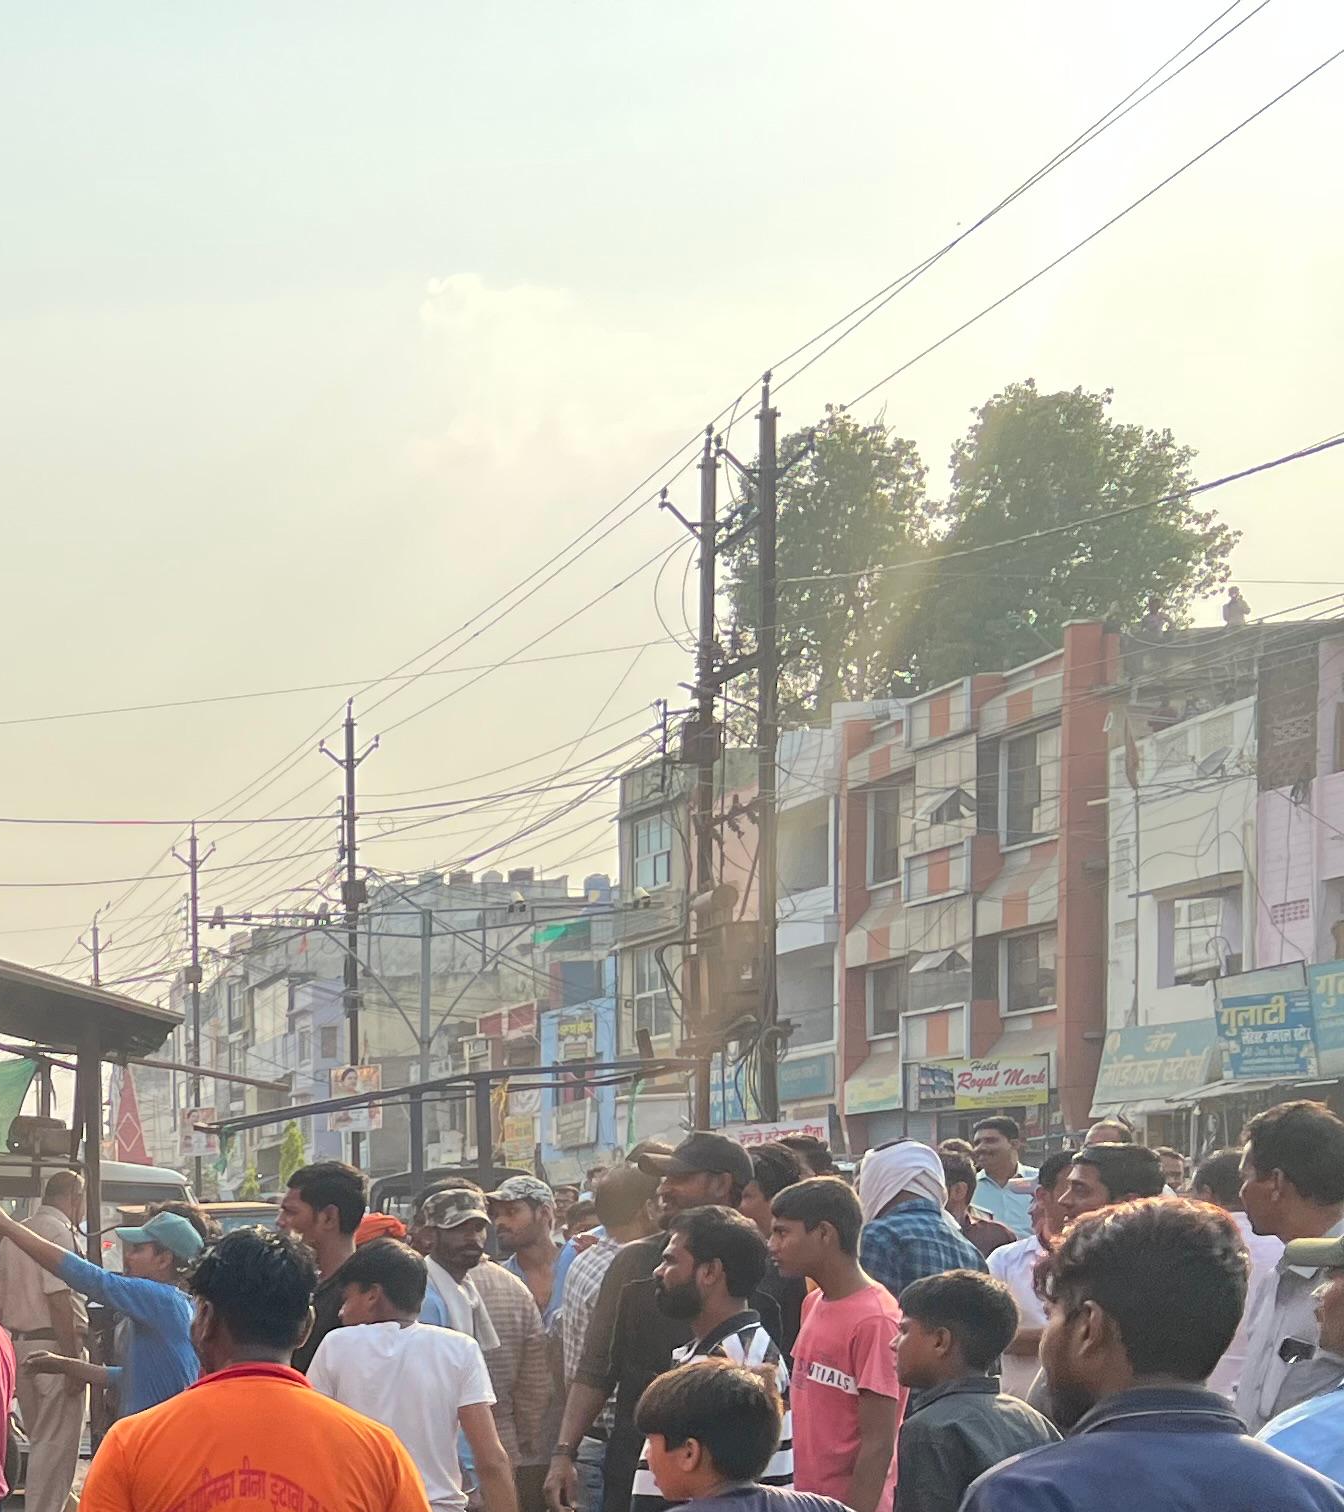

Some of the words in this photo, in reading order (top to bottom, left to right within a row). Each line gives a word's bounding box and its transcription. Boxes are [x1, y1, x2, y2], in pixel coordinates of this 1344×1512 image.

[1220, 994, 1288, 1037] गुलाटी
[957, 1072, 999, 1093] Royal
[1003, 1067, 1047, 1087] Mark
[970, 1060, 1000, 1072] Hotel
[238, 1456, 267, 1500] बीना
